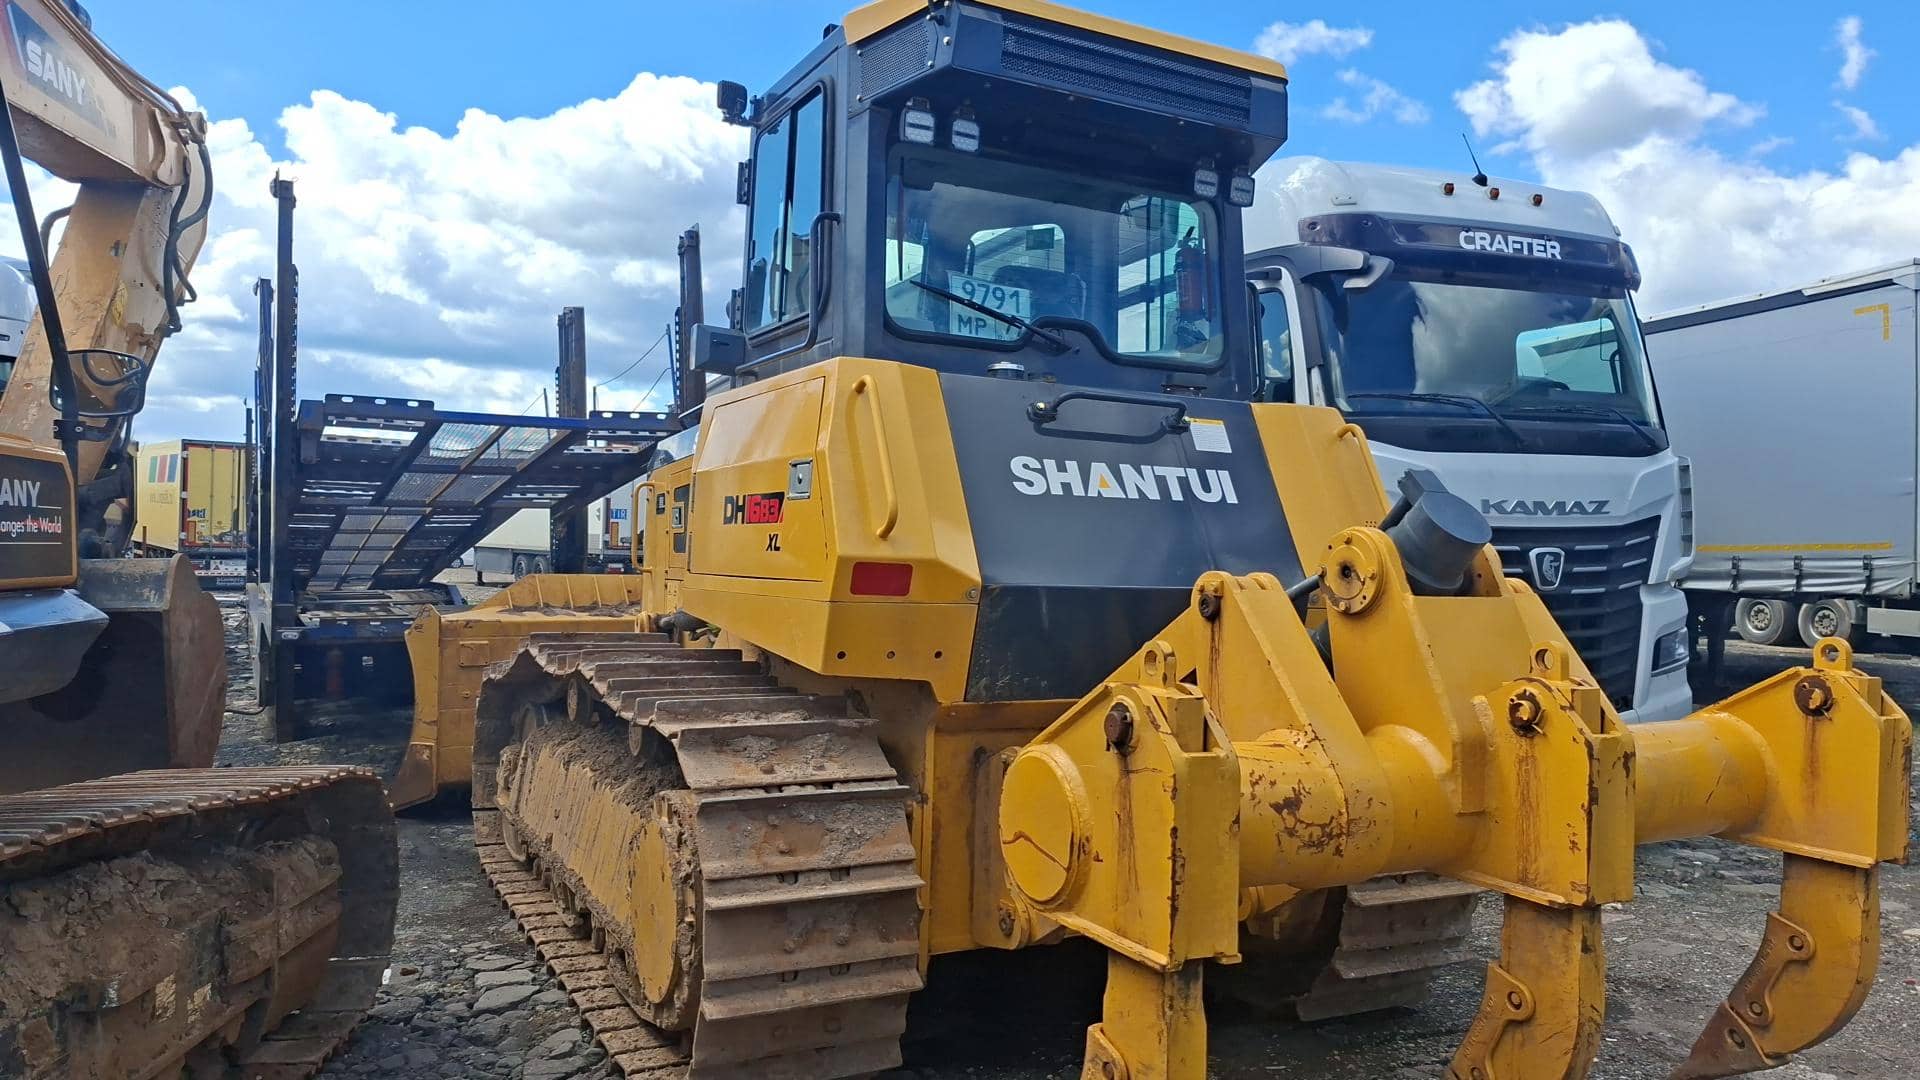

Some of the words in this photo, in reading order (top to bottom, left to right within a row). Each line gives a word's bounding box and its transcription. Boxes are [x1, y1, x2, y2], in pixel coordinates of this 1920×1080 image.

[27, 40, 85, 104] SANY
[1459, 230, 1562, 260] CRAFTER
[962, 280, 1021, 314] 9791
[1010, 455, 1238, 504] SHANTUI
[1481, 499, 1610, 516] KAMAZ
[26, 514, 38, 533] the
[39, 515, 62, 533] World
[766, 533, 781, 551] XL
